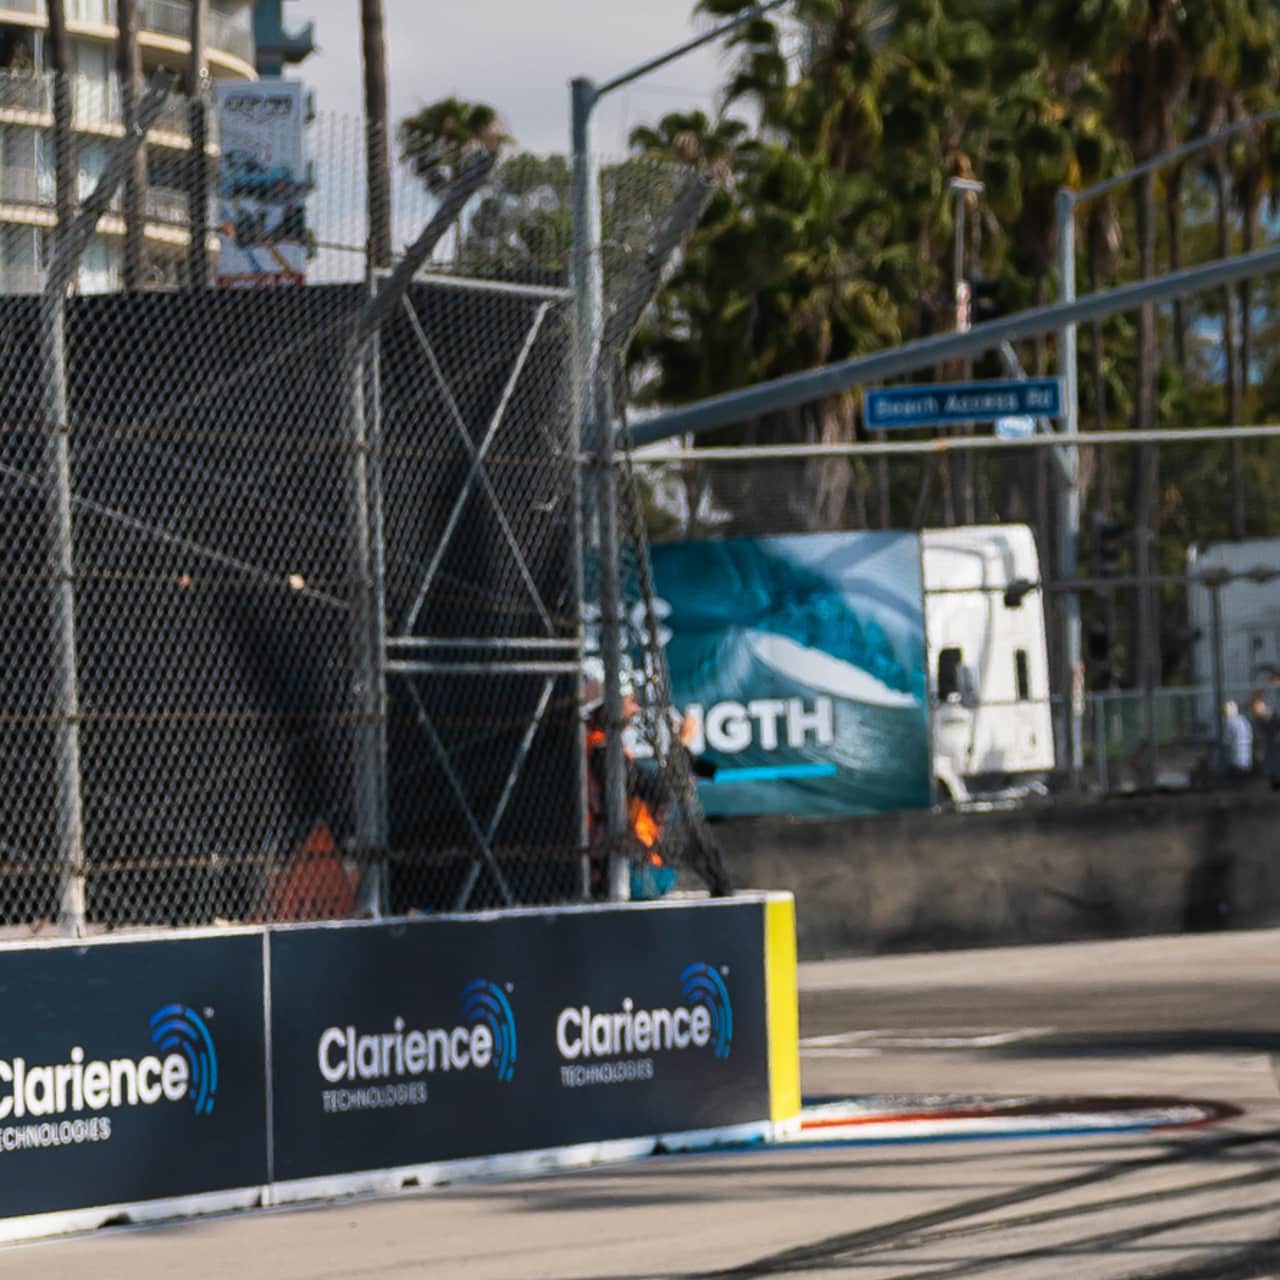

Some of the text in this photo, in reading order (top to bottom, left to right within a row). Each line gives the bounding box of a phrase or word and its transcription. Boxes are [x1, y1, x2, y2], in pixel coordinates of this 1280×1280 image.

[876, 388, 1052, 417] Beach Access Rd
[318, 1016, 494, 1083] Clarience
[556, 997, 712, 1060] Clarience
[322, 1081, 427, 1113] TECHNOLOGIES
